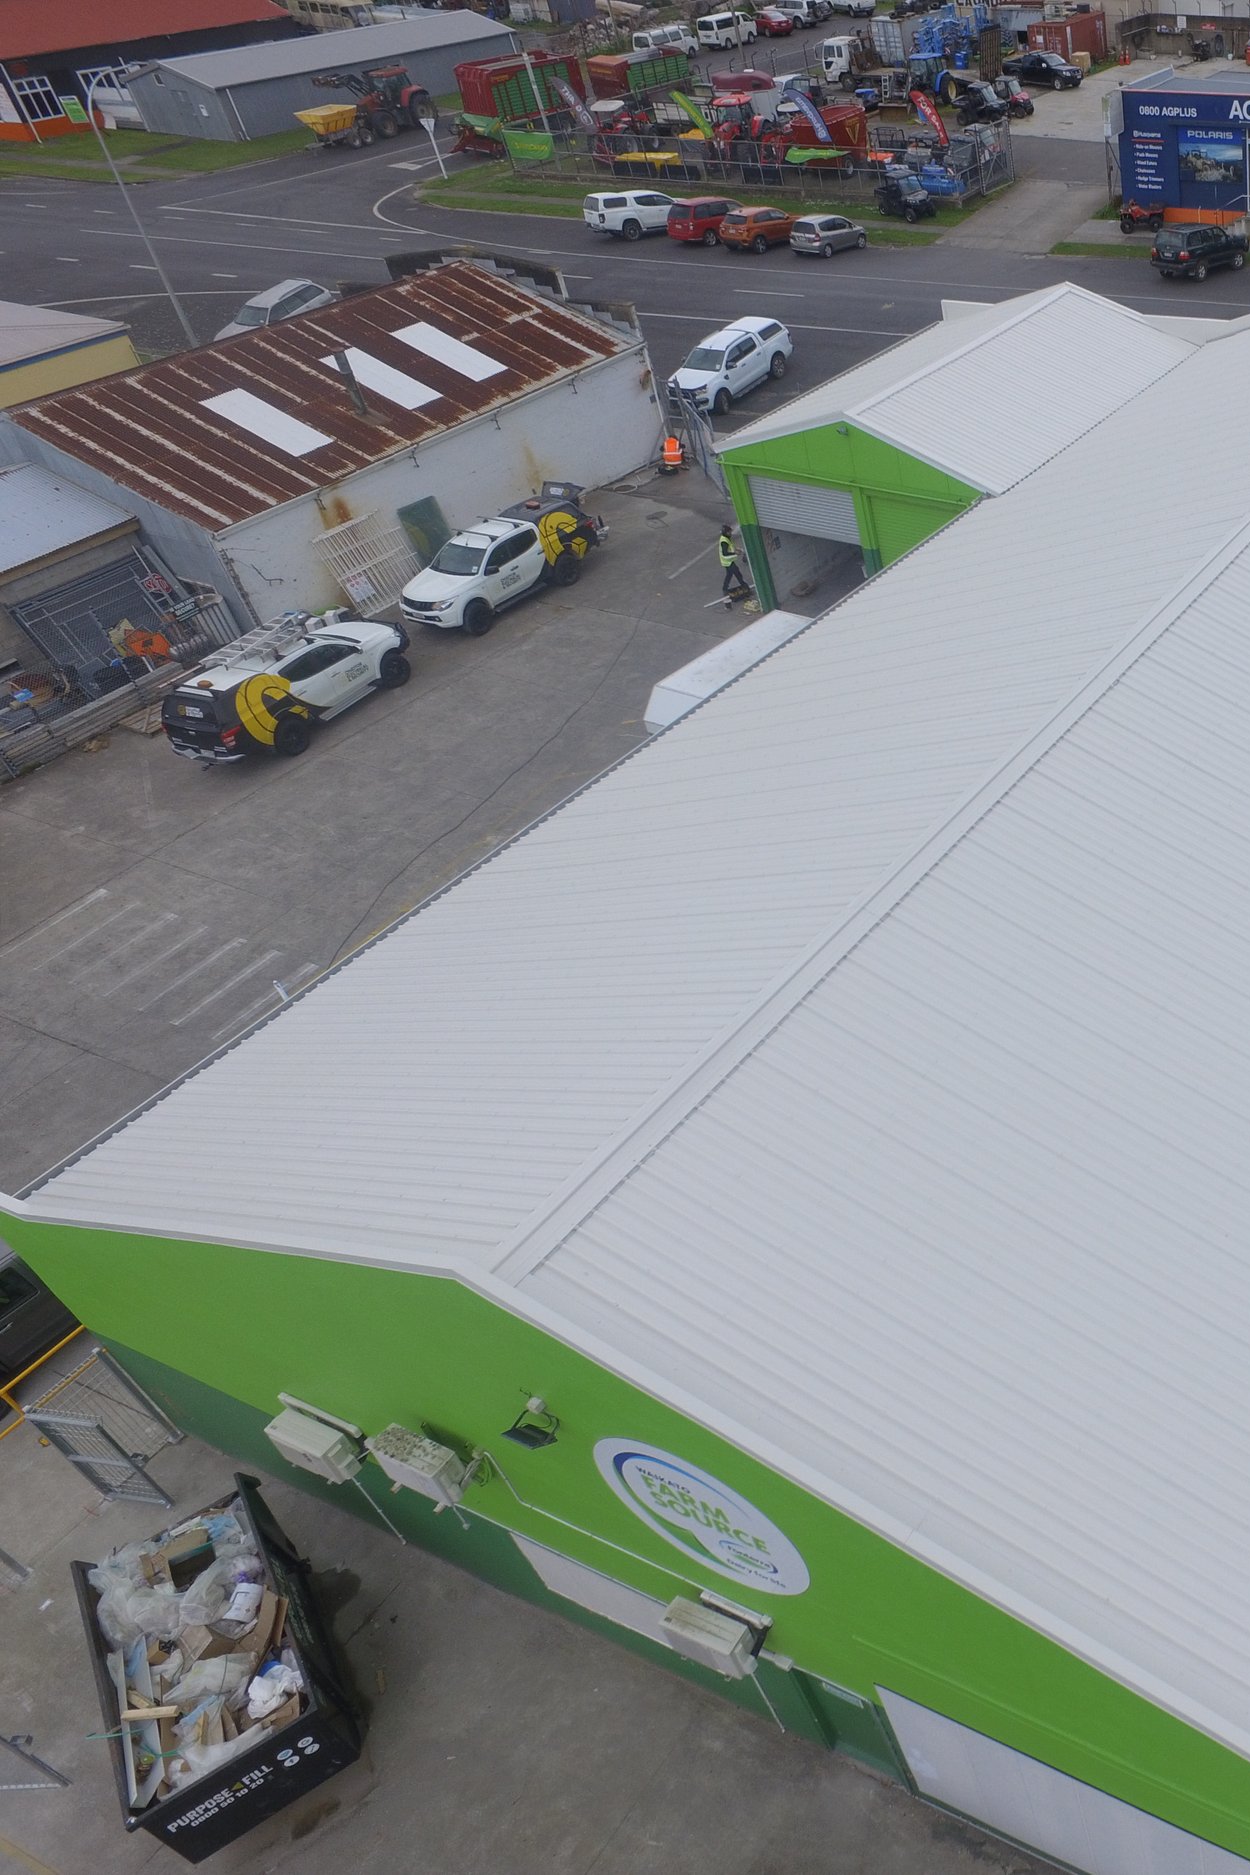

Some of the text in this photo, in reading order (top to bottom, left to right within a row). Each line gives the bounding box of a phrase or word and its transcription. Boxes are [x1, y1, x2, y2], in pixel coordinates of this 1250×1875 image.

[918, 97, 932, 115] FOR
[1139, 105, 1197, 118] 0800 AGPLUS
[1187, 130, 1234, 140] POLARIS
[641, 1474, 730, 1525] FARM
[649, 1491, 771, 1556] SOURCE
[166, 1765, 274, 1833] PURPOSE FILL
[220, 1797, 235, 1808] 50
[235, 1788, 249, 1798] 10
[249, 1778, 264, 1789] 20
